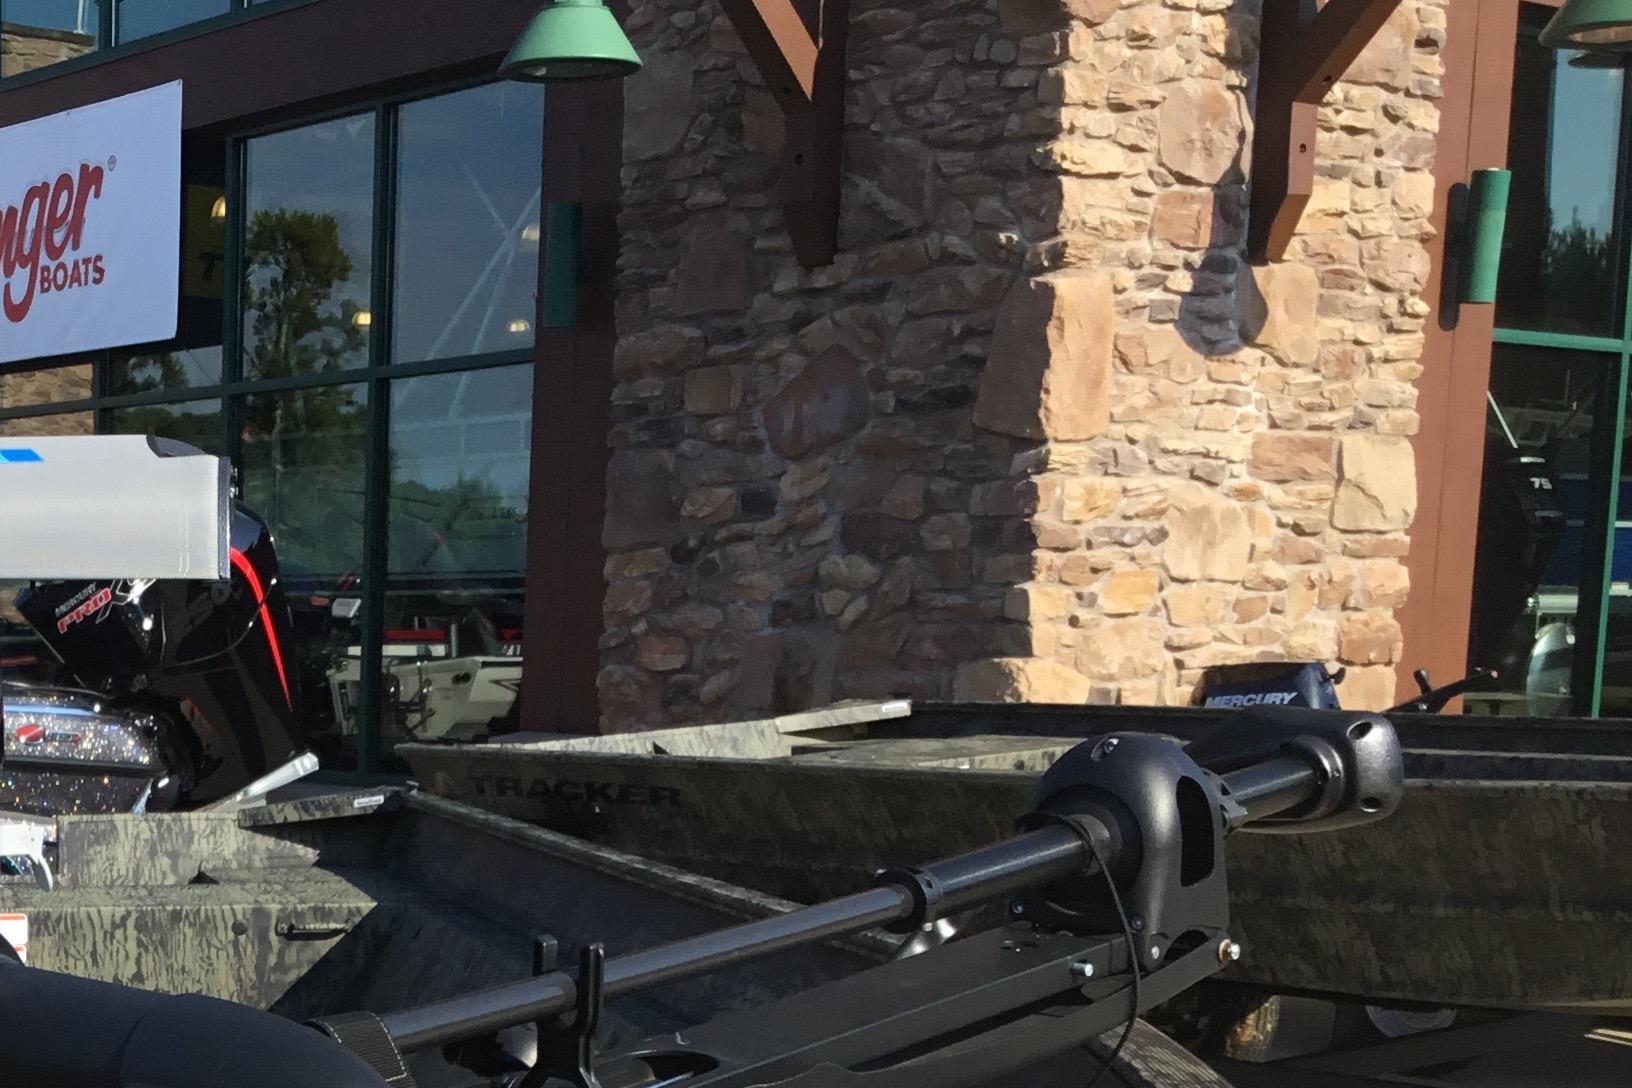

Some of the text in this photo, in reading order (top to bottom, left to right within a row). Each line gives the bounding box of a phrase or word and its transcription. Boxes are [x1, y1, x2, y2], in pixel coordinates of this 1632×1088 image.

[39, 254, 106, 294] BOATS
[1528, 477, 1553, 490] 75
[57, 587, 112, 635] PRO
[1203, 691, 1299, 709] MERCURY
[469, 774, 682, 805] TRACKER
